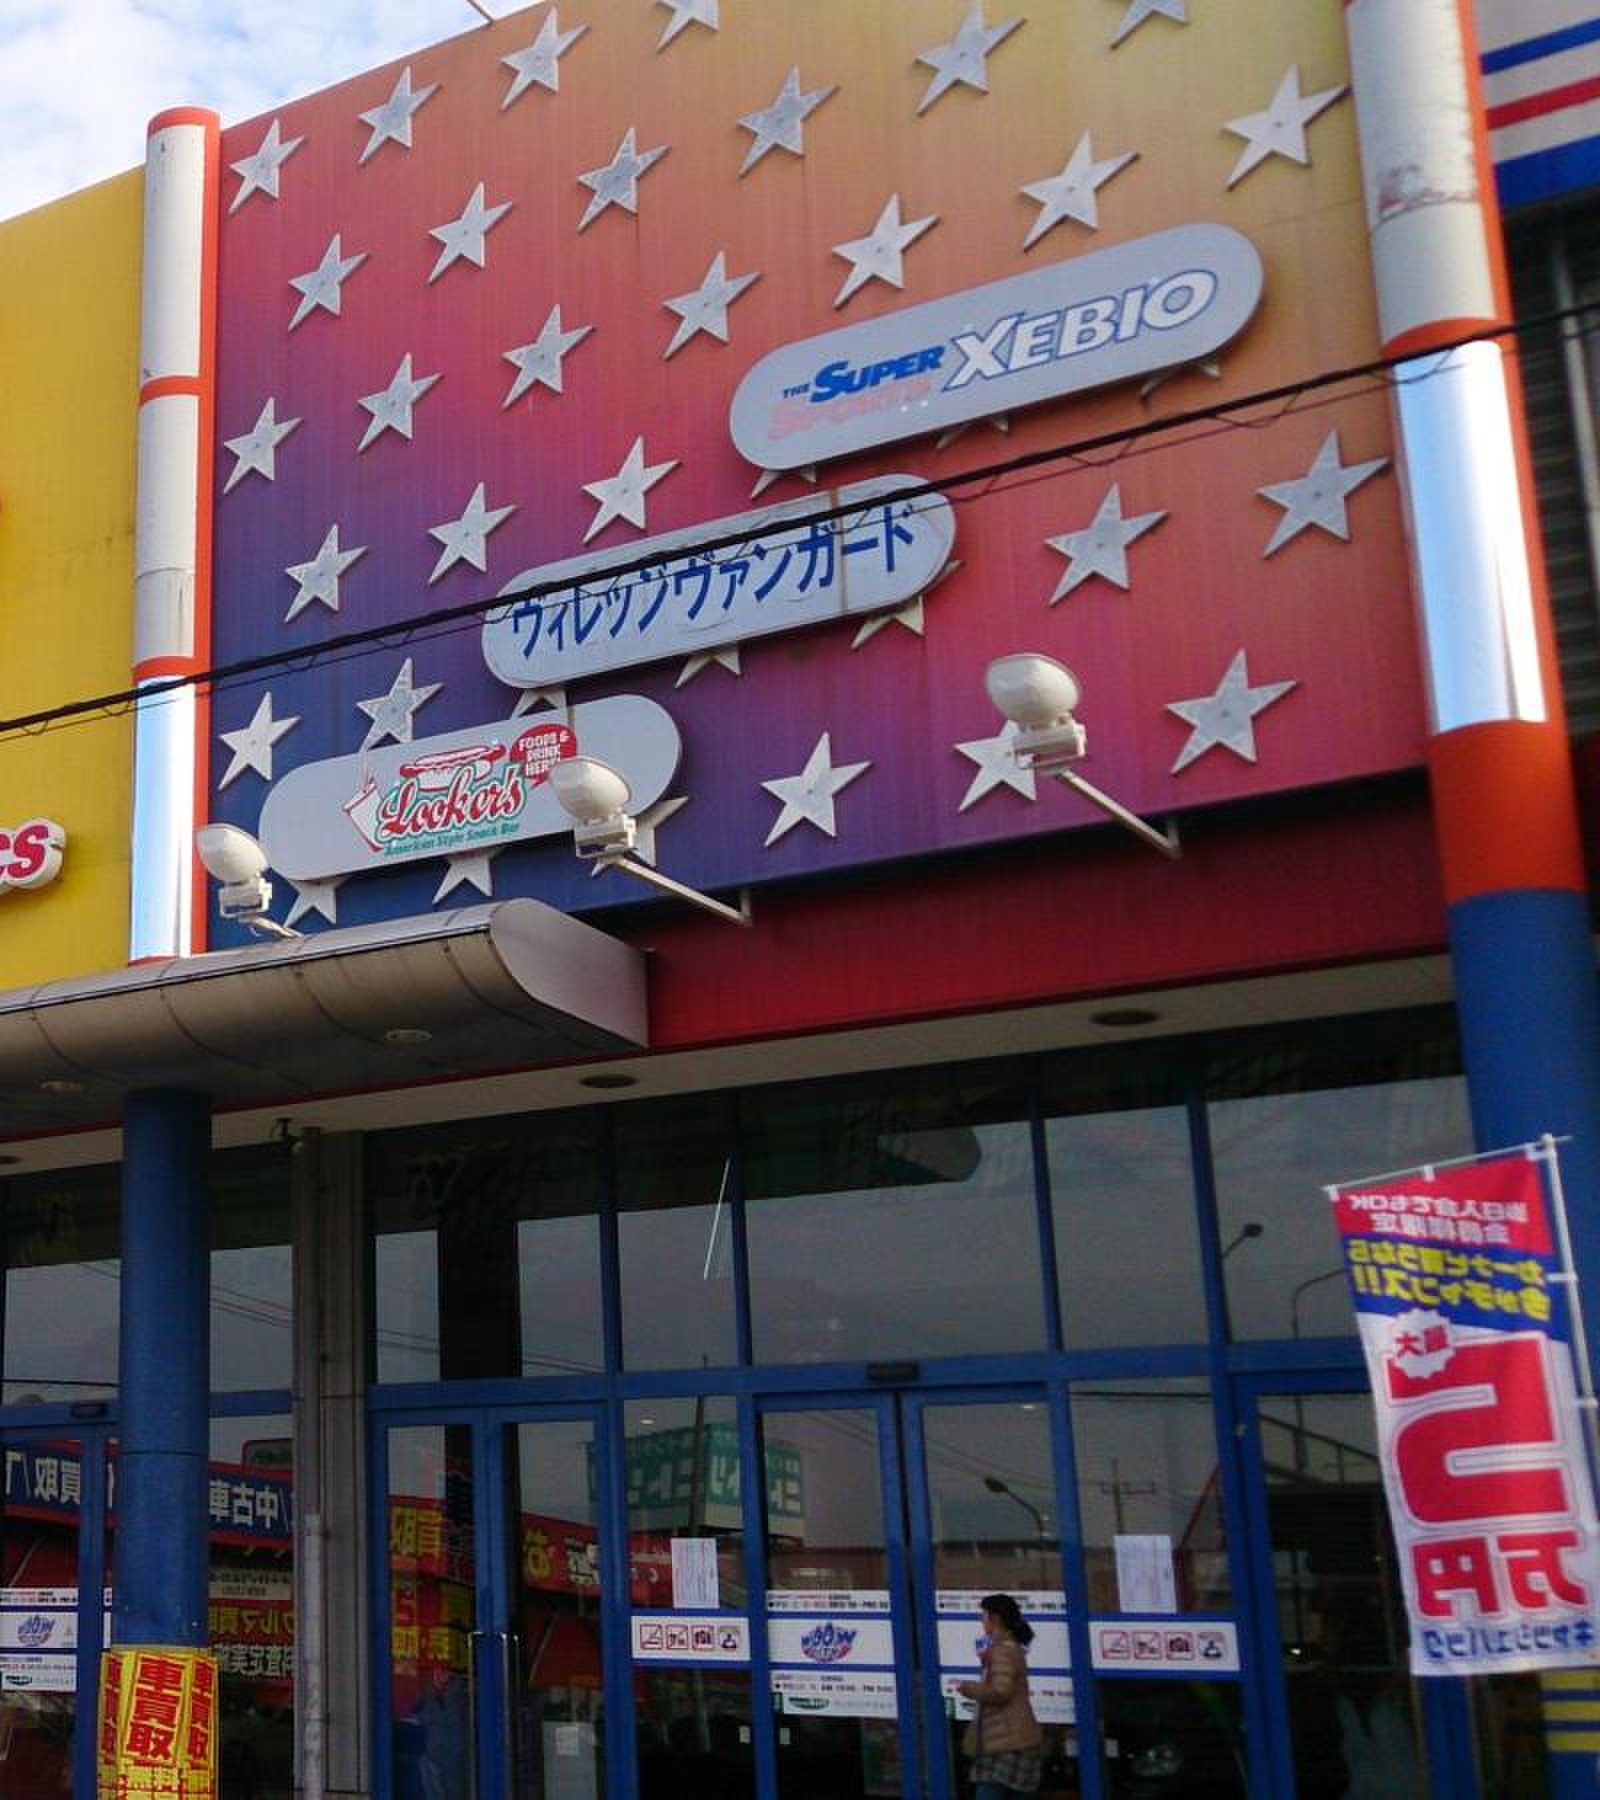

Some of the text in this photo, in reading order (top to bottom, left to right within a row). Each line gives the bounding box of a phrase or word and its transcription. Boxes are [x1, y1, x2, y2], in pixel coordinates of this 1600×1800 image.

[810, 345, 947, 403] SUPER
[941, 269, 1218, 393] XEBIO
[511, 503, 918, 658] ヴィレッジヴァンガード
[126, 1655, 185, 1760] 車買取
